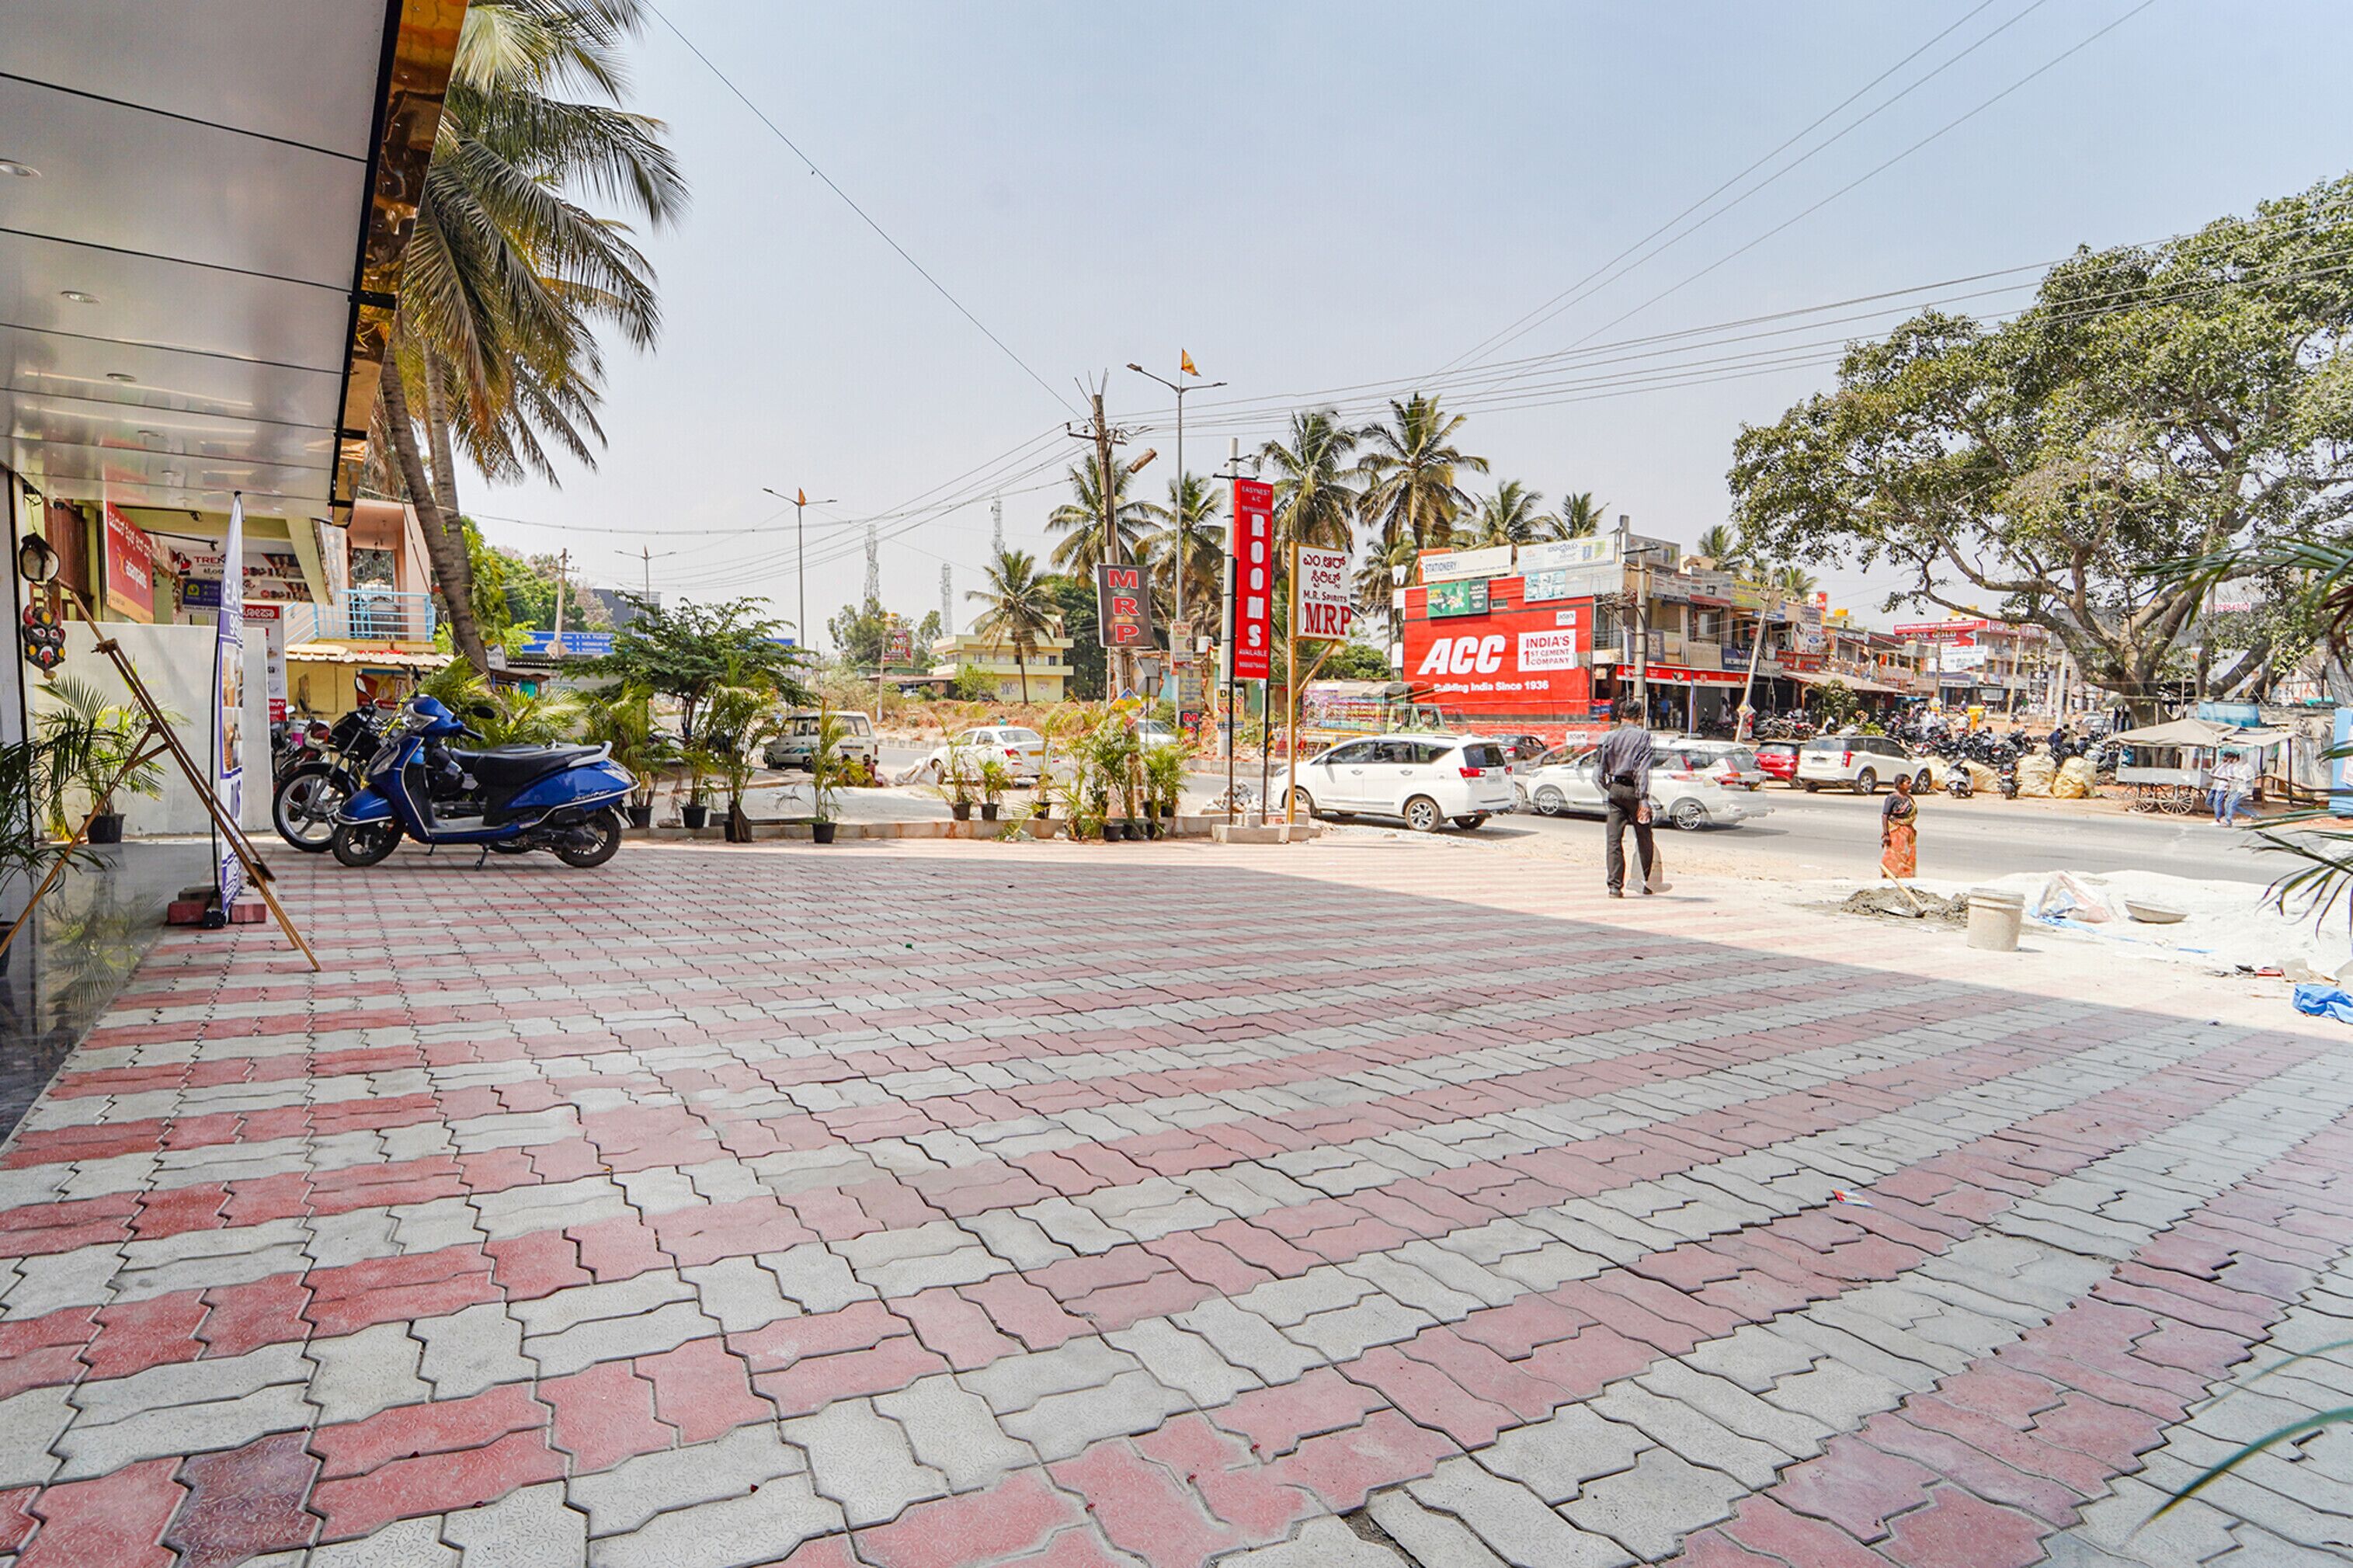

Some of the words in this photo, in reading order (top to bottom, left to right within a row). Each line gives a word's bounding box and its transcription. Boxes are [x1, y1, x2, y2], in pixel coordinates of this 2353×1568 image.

[1425, 561, 1456, 573] STATIONERY
[1305, 602, 1351, 635] MRP
[1526, 635, 1569, 649] INDIA'S
[1416, 635, 1506, 675] ACC
[1471, 683, 1493, 691] India
[1496, 682, 1522, 691] Since
[1524, 680, 1549, 690] 1936
